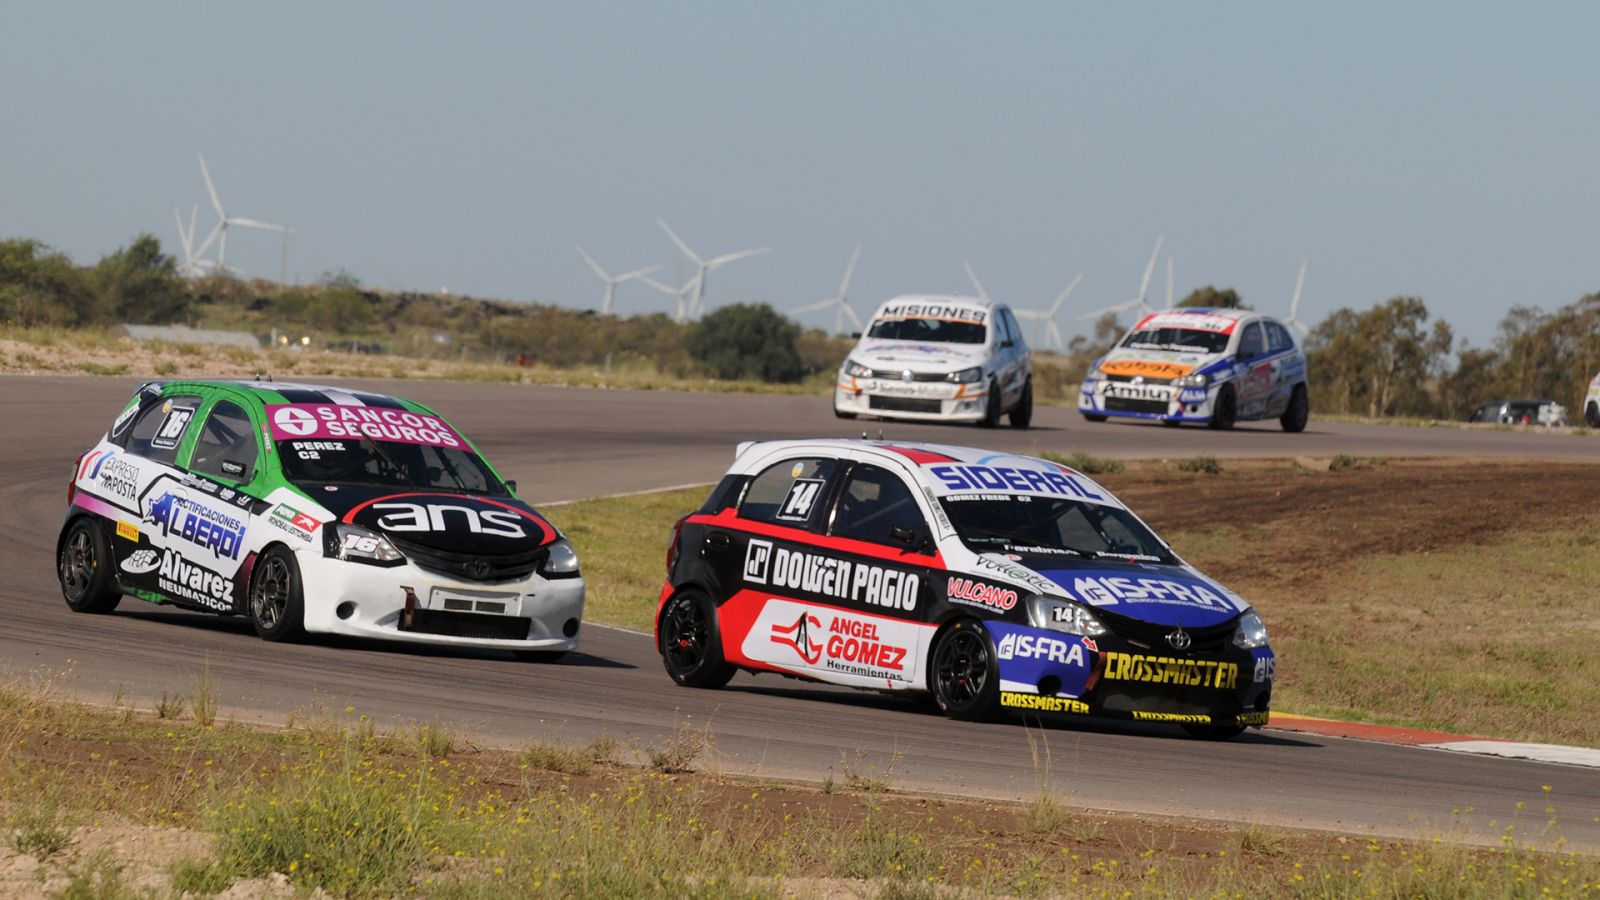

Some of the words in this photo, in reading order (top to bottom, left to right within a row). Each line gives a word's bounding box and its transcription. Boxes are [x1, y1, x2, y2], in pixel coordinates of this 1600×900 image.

[883, 305, 986, 324] MISIONES
[1102, 383, 1171, 400] Amiun
[160, 411, 190, 438] 16
[317, 407, 449, 432] SANCOR
[292, 442, 346, 451] PEREZ
[325, 421, 459, 447] SEGUROS
[298, 451, 321, 460] C2
[930, 465, 1105, 500] SIDERAL
[785, 483, 820, 515] 14
[946, 494, 981, 502] GOMEZ
[150, 490, 246, 561] ALBERDI
[373, 503, 527, 538] ans
[344, 534, 380, 552] 16
[159, 548, 234, 603] Alvarez
[773, 548, 851, 599] DOWEN
[851, 563, 919, 611] PAGIO
[159, 577, 232, 611] NEUMATICOS
[947, 576, 1018, 610] VULCANO
[1054, 607, 1074, 622] 14
[829, 616, 880, 641] ANGEL
[826, 635, 907, 670] GOMEZ
[827, 659, 903, 681] Herramientas
[1104, 651, 1238, 689] CROSSMASTER
[1001, 691, 1090, 714] CROSSMASTER
